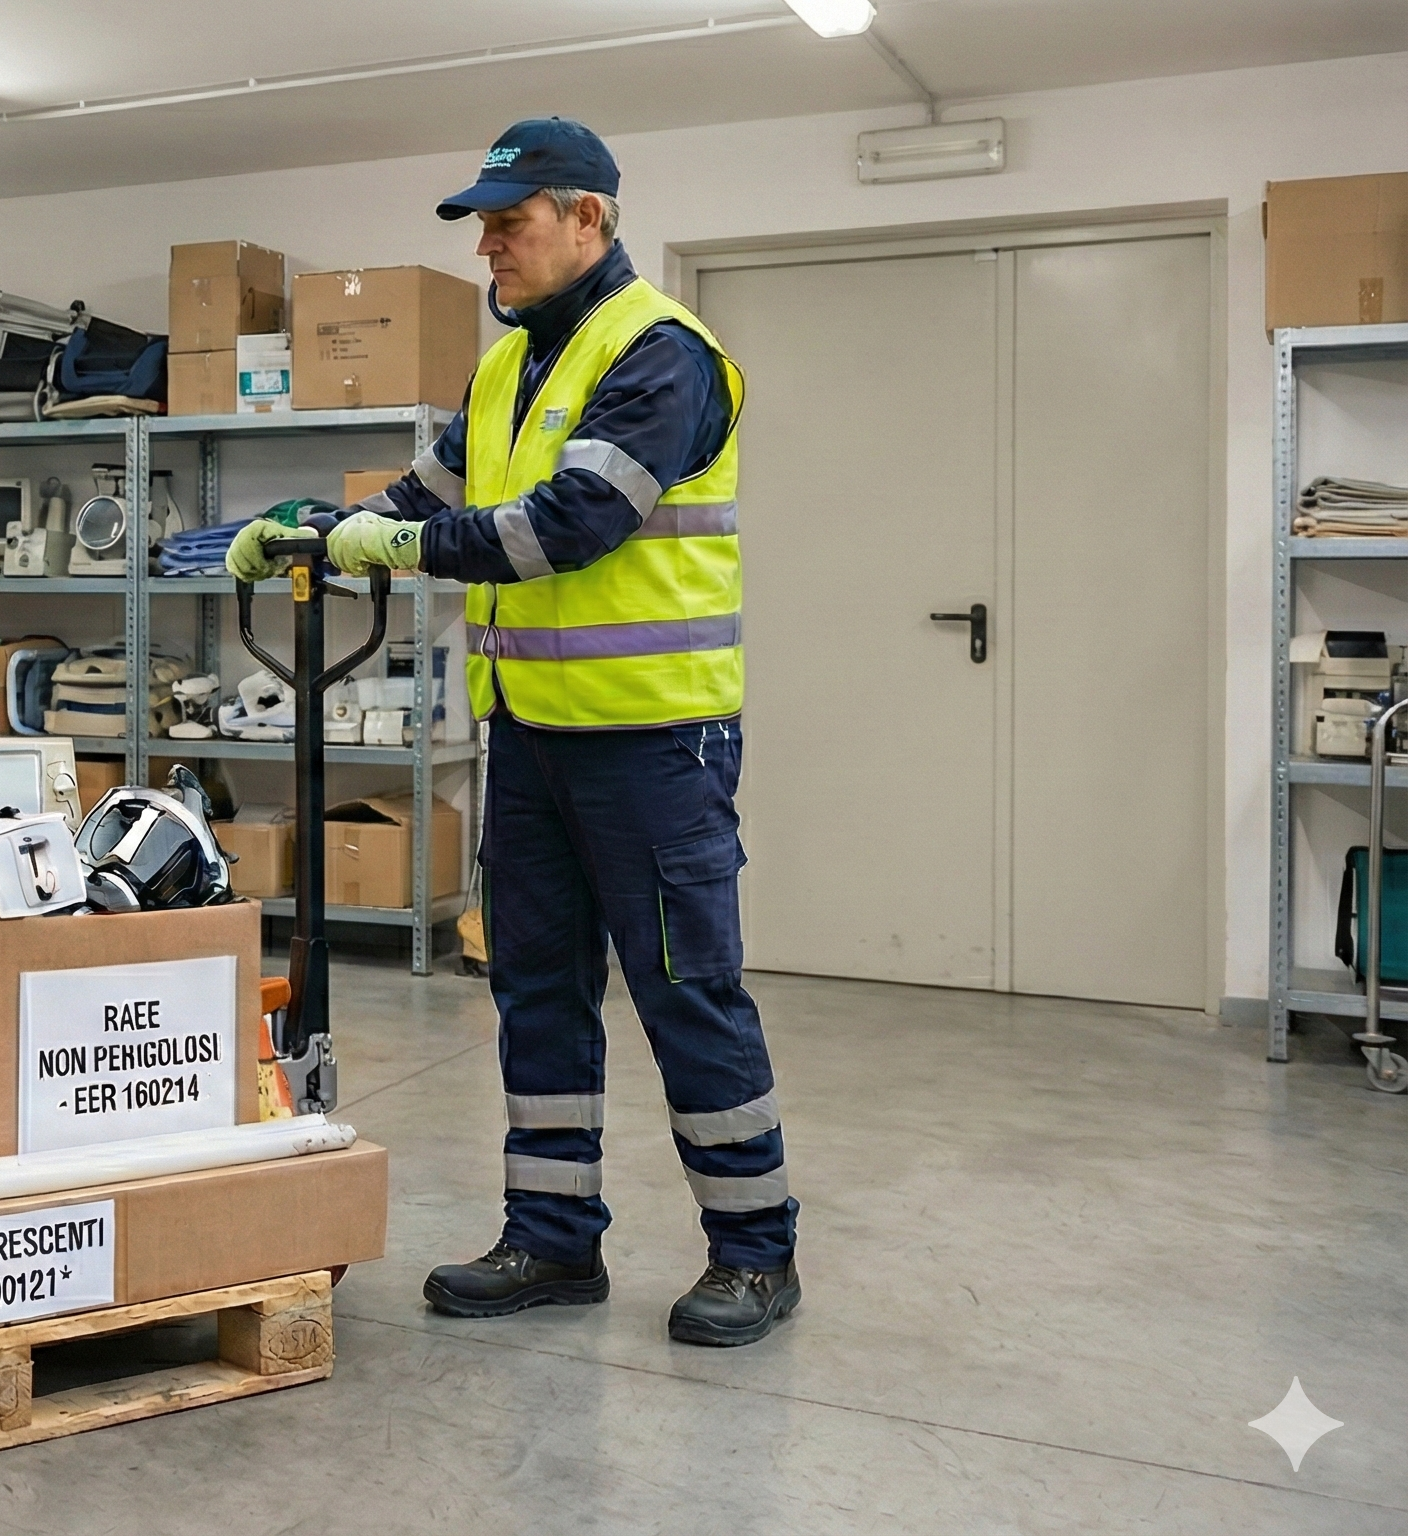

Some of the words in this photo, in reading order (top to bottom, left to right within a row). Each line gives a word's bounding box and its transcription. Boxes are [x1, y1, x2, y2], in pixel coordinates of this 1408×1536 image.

[104, 1000, 161, 1032] RAEE
[39, 1046, 86, 1079] NON
[75, 1084, 117, 1115] EER
[122, 1073, 200, 1110] 160214
